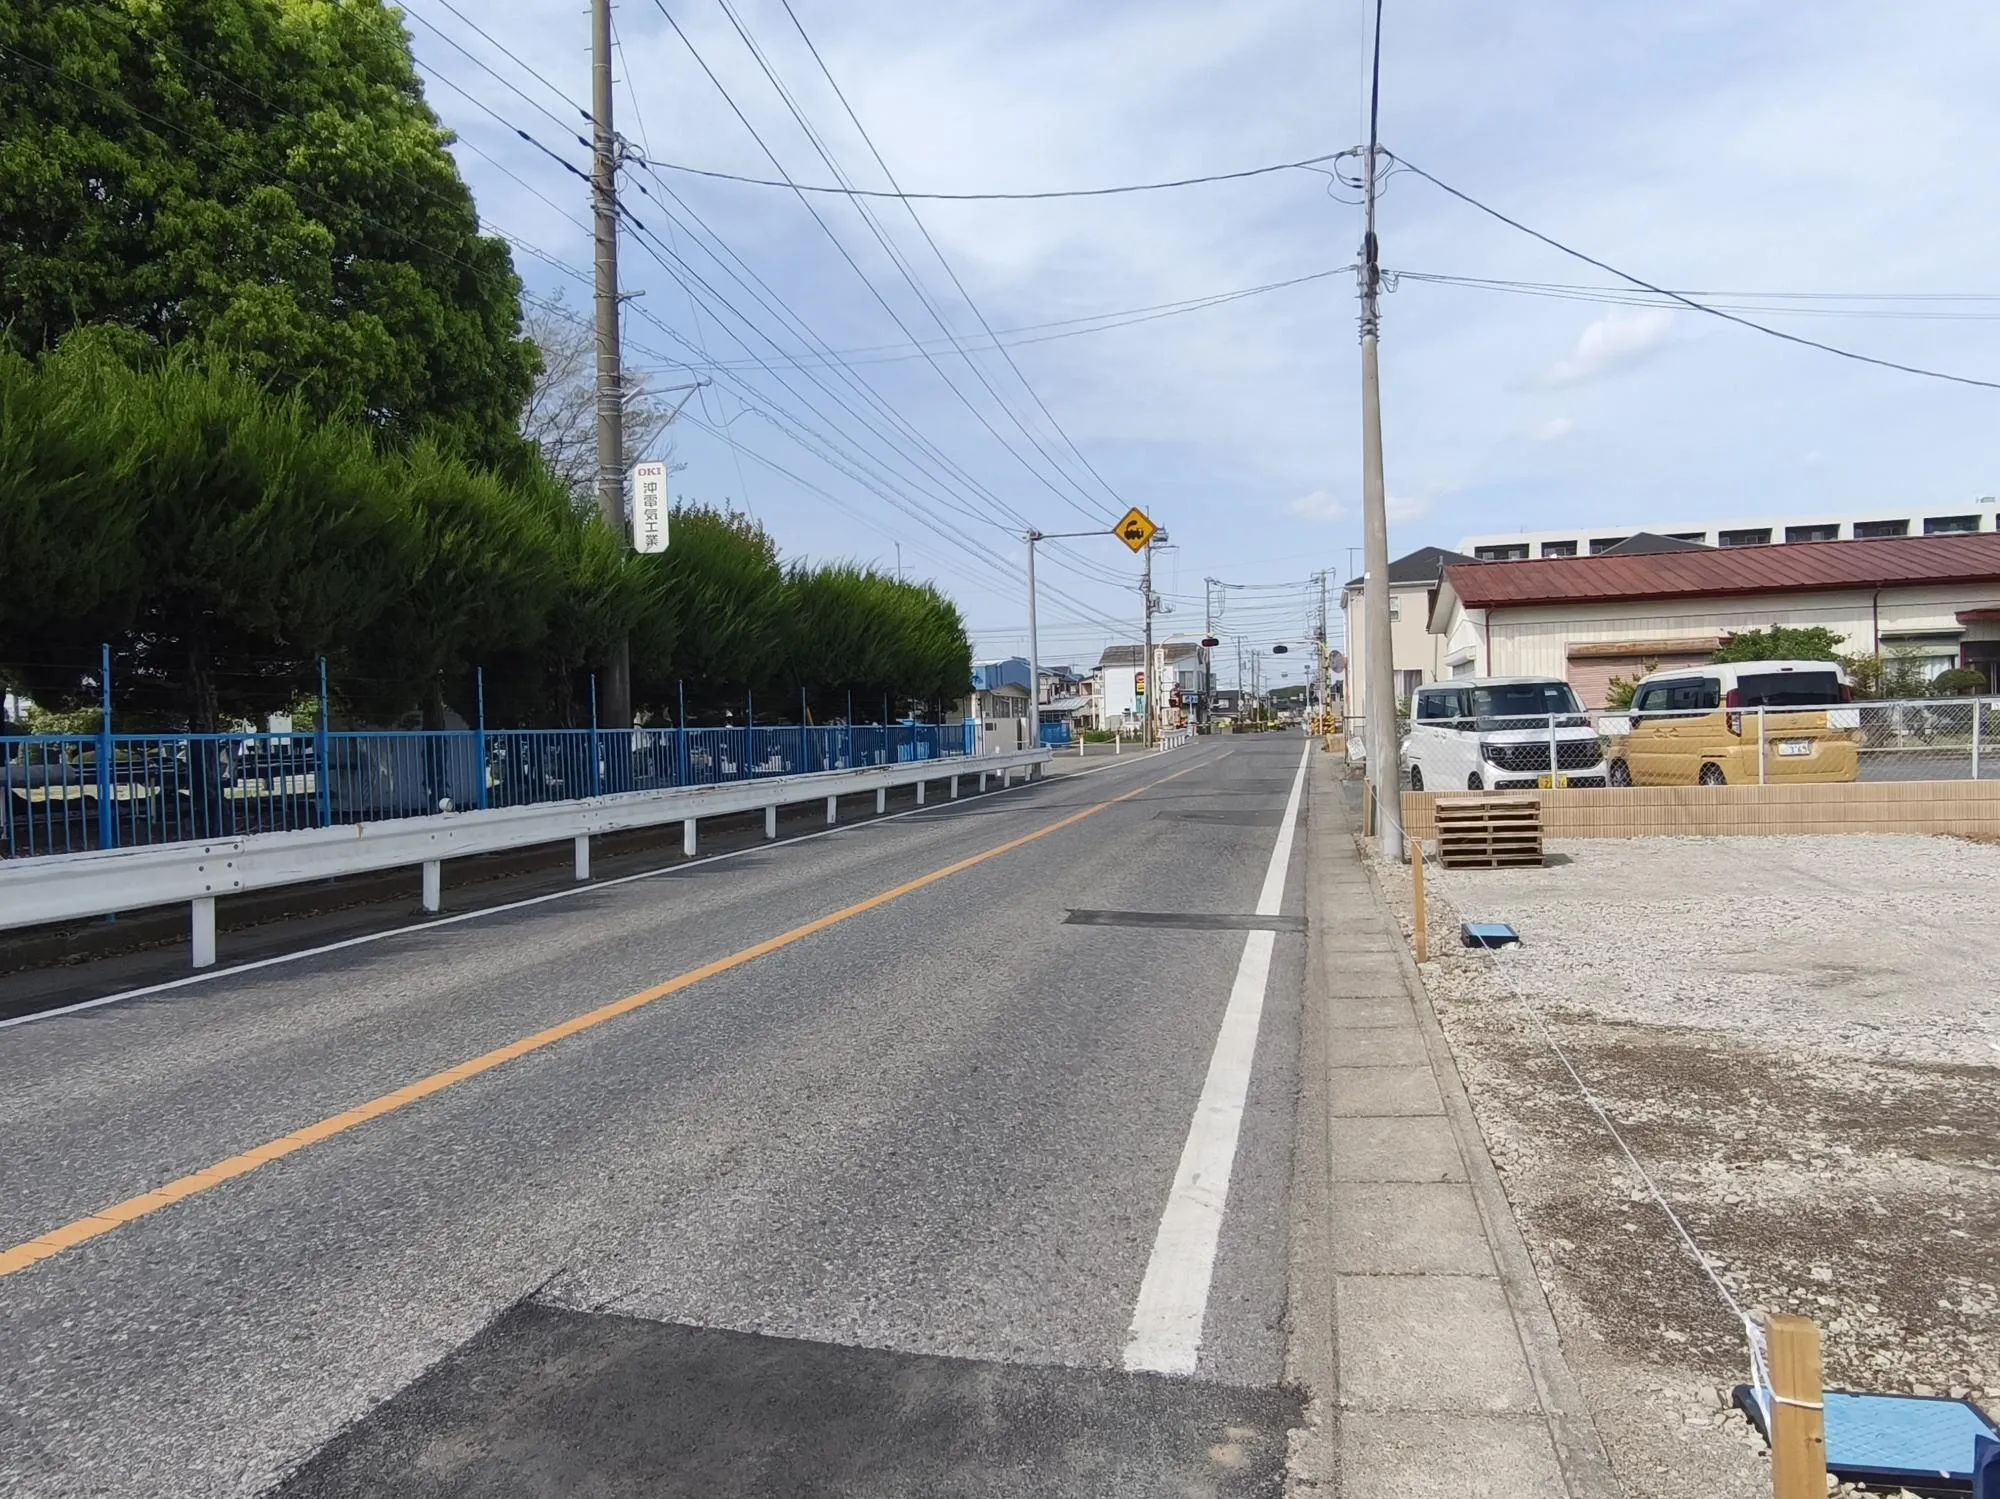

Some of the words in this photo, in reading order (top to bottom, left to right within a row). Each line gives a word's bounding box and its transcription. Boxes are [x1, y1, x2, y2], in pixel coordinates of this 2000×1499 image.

[638, 467, 661, 476] OKI
[643, 482, 658, 546] 沖電気工業
